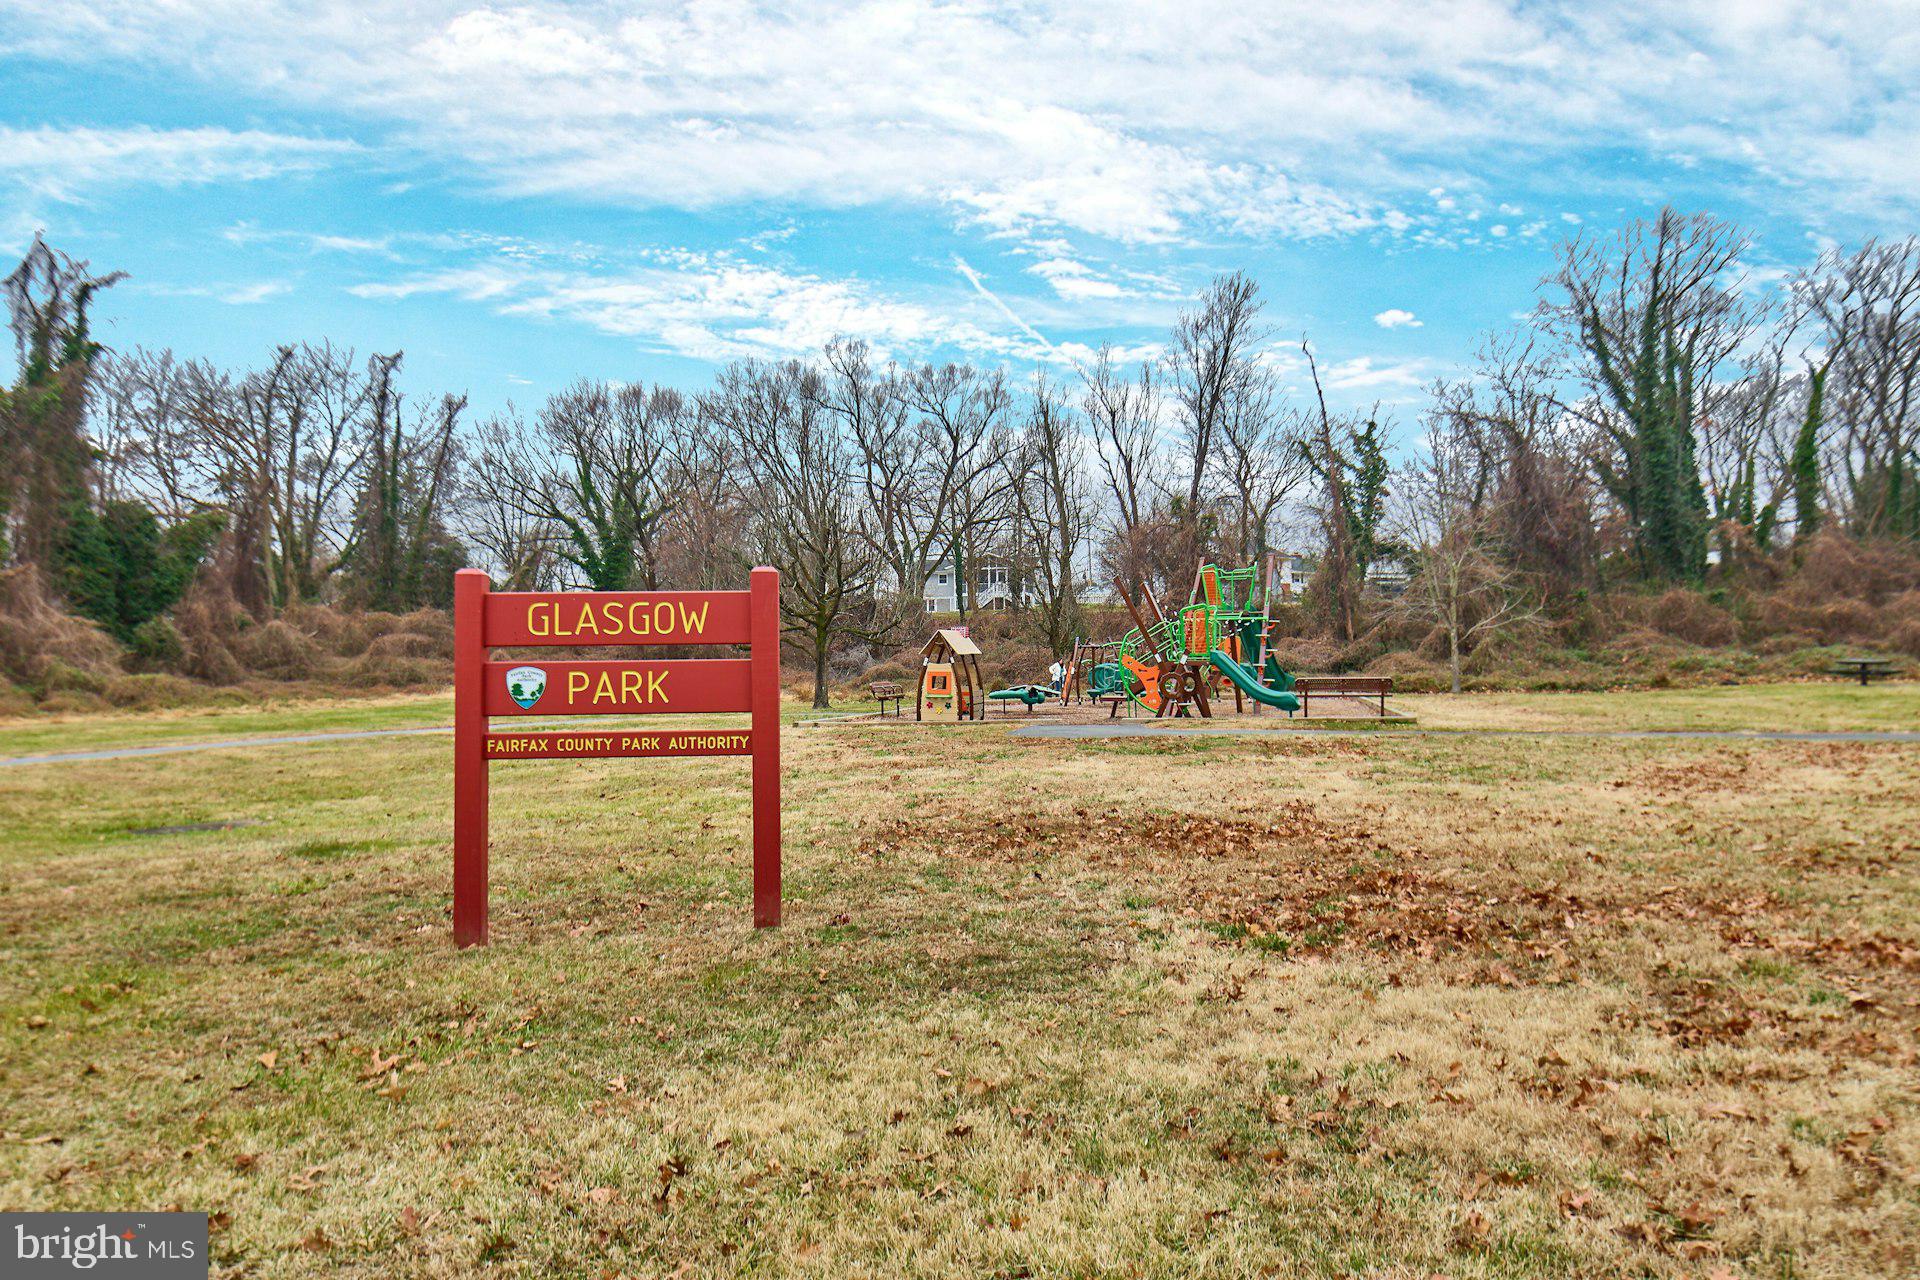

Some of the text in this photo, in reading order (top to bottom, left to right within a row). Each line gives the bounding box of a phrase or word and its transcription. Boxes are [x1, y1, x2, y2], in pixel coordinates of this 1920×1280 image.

[527, 601, 709, 636] GLASGOW
[568, 670, 669, 705] PARK
[487, 735, 750, 753] FAIRFAX COUNTY PARK AUTHORITY
